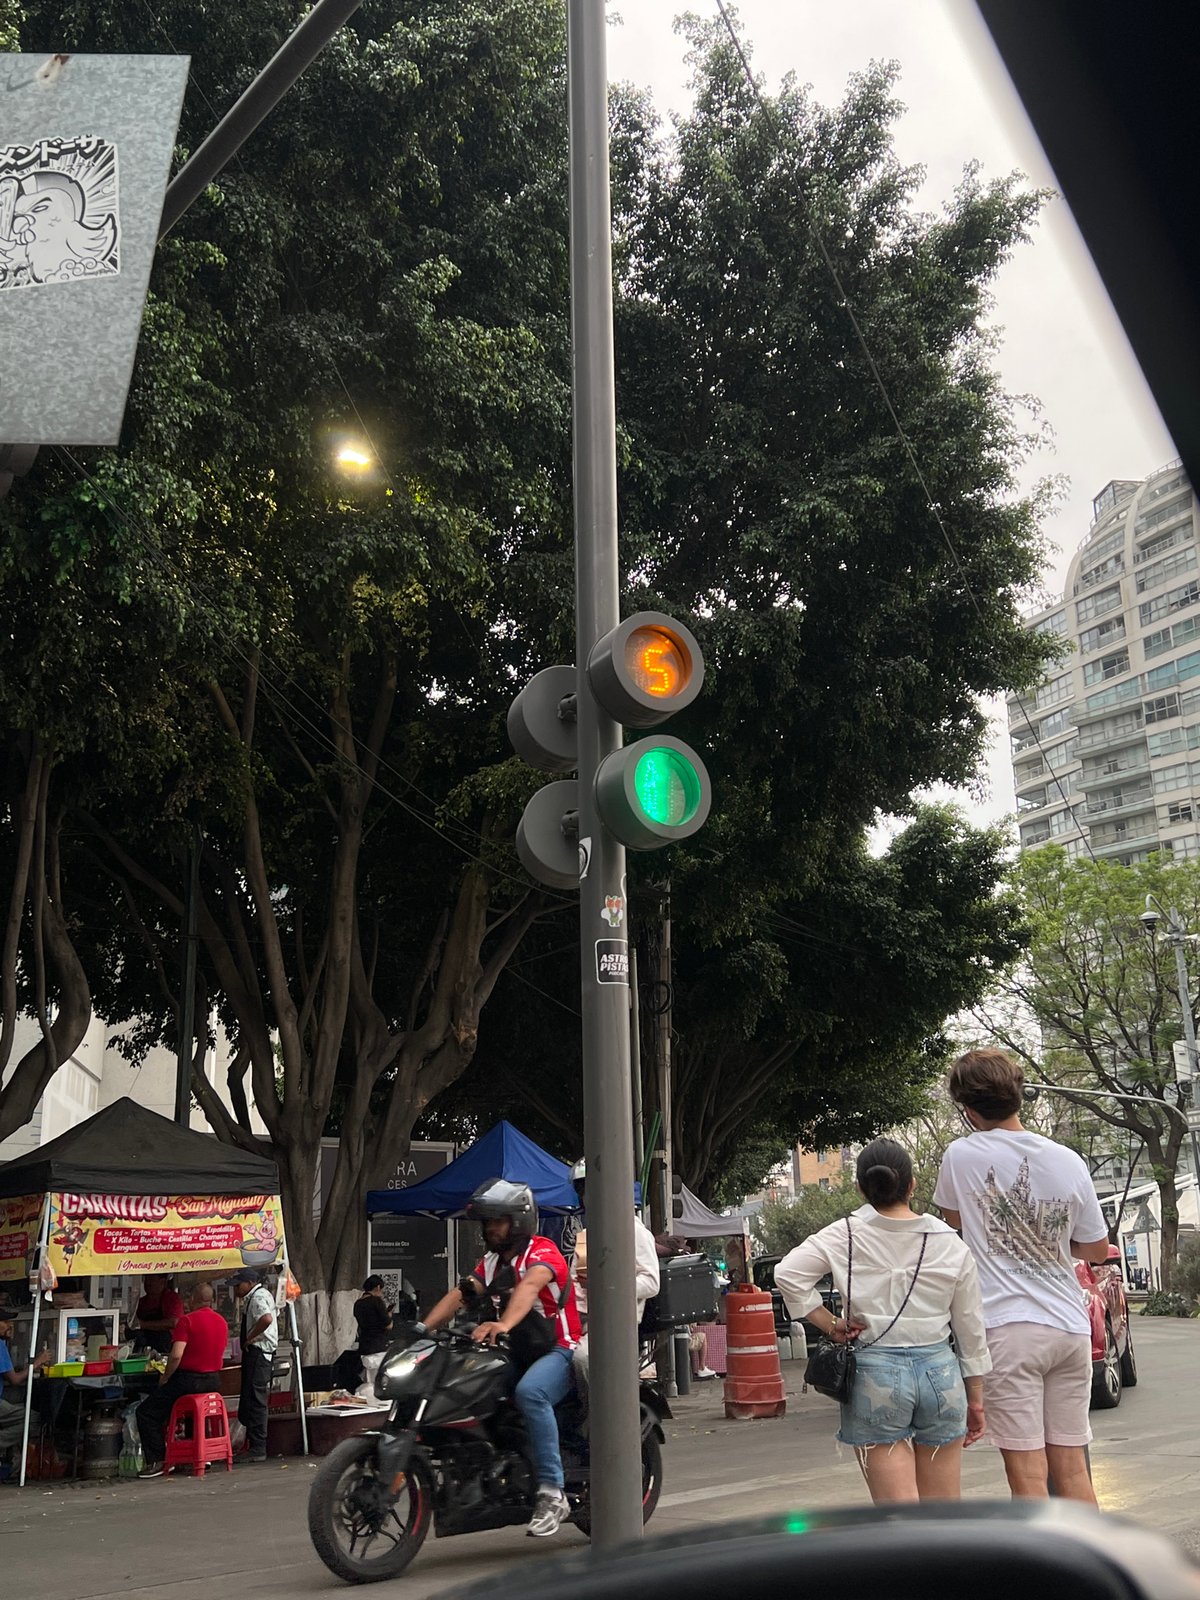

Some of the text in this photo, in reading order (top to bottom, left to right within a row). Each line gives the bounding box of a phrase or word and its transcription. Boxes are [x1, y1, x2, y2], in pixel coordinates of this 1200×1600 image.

[644, 648, 669, 692] 5
[62, 1193, 167, 1217] CARNITAS
[179, 1196, 206, 1213] San
[118, 1236, 132, 1244] Kilo
[112, 1244, 139, 1252] Lengua
[181, 1241, 205, 1250] Trompa
[154, 1262, 167, 1271] por
[170, 1261, 179, 1269] su
